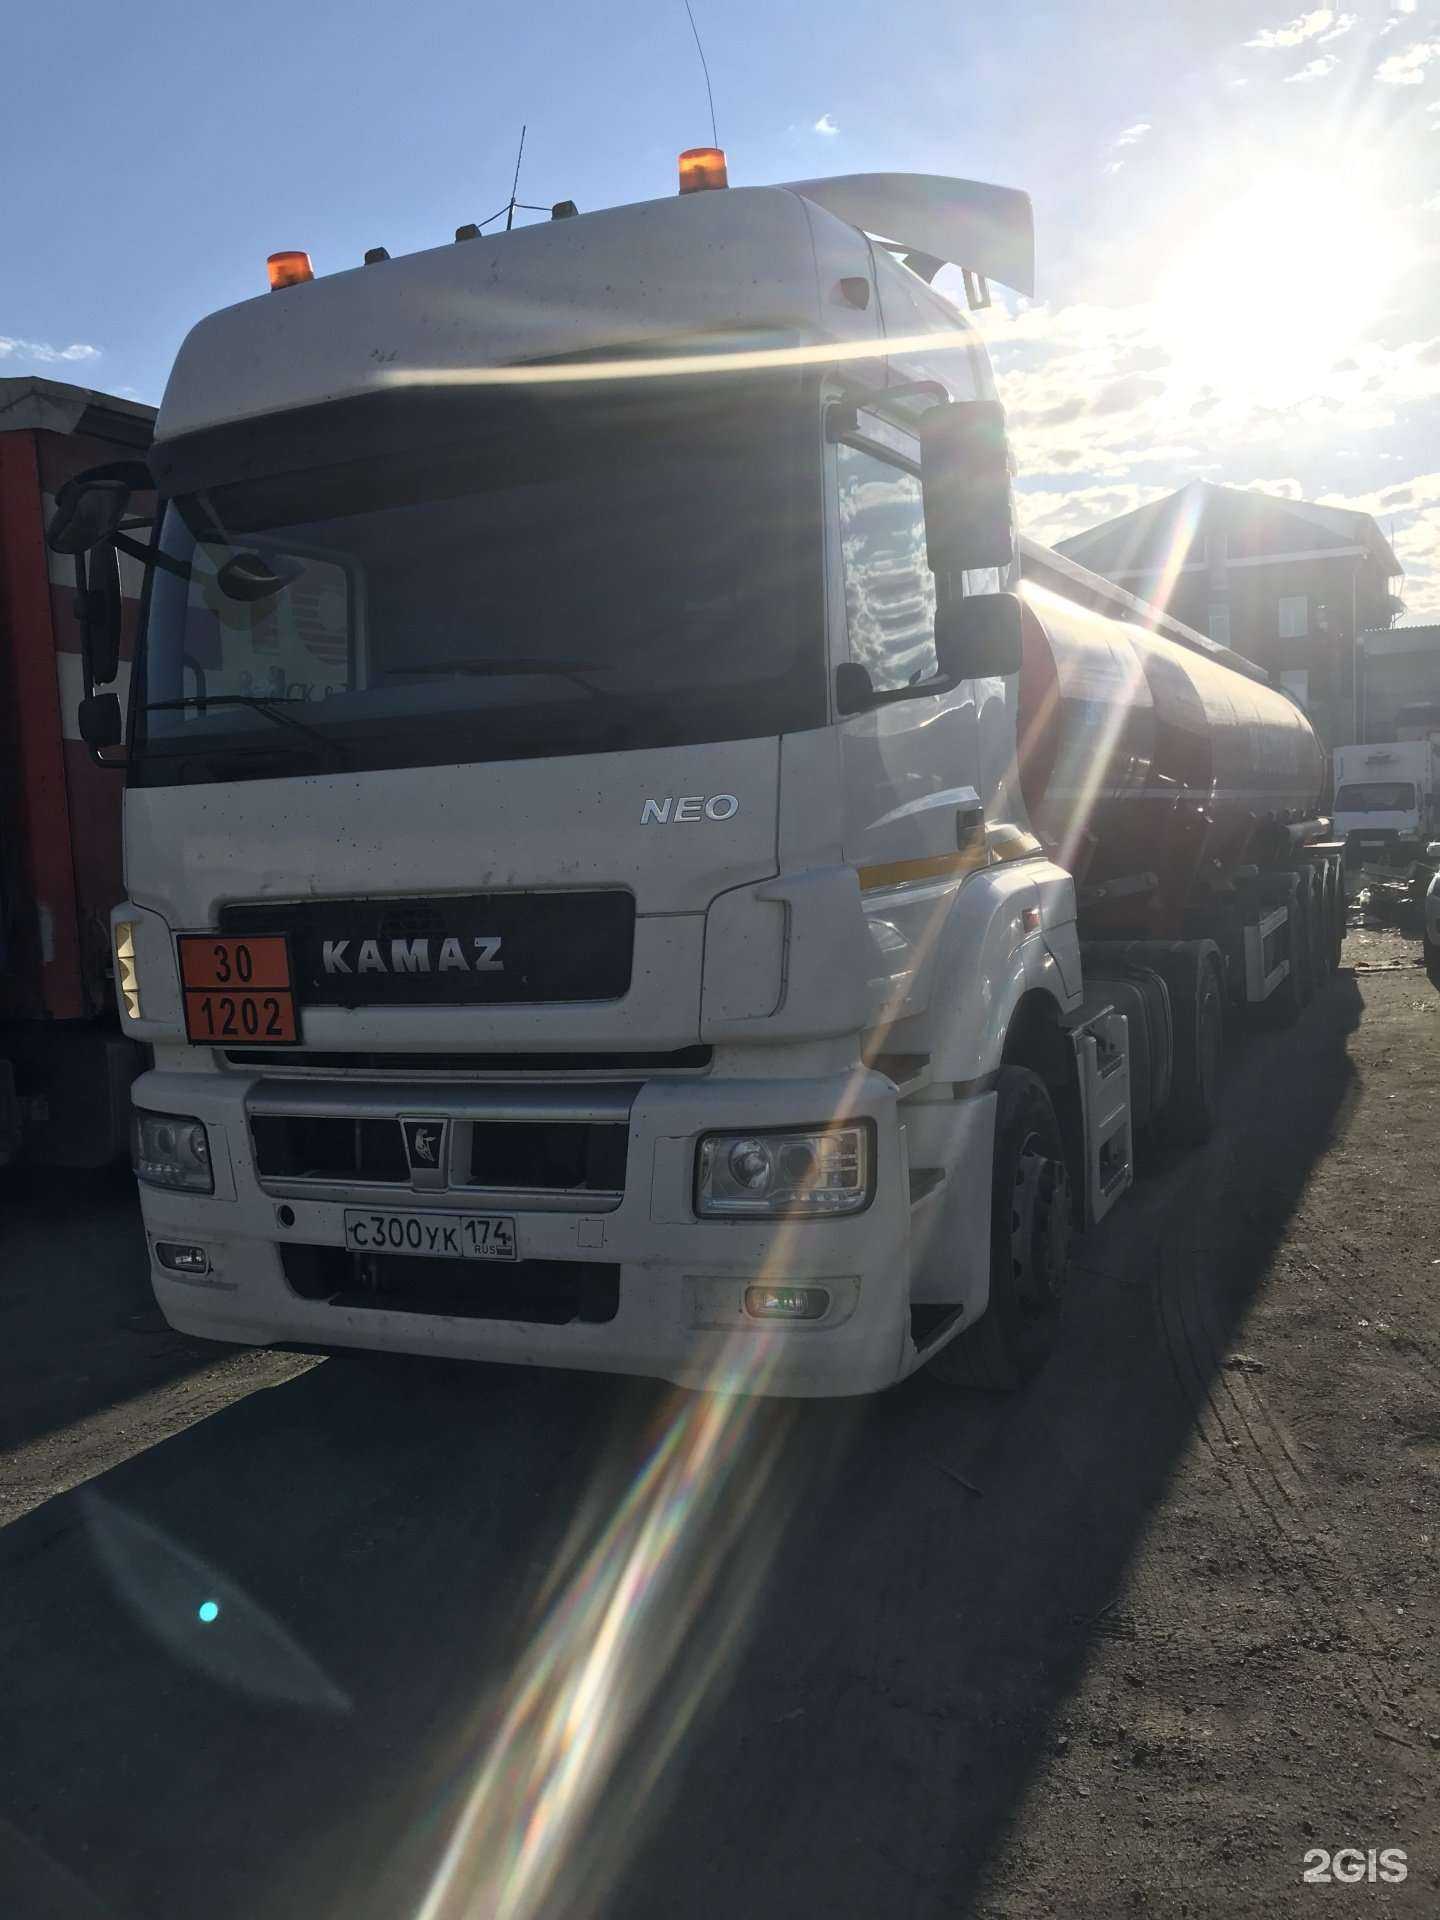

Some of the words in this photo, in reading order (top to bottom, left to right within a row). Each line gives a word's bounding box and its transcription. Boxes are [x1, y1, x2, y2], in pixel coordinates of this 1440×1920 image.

[640, 794, 739, 824] NEO
[214, 945, 254, 983] 30
[322, 937, 505, 974] KAMAZ
[201, 997, 284, 1037] 1202
[464, 1219, 512, 1246] 174
[474, 1245, 497, 1256] RUS
